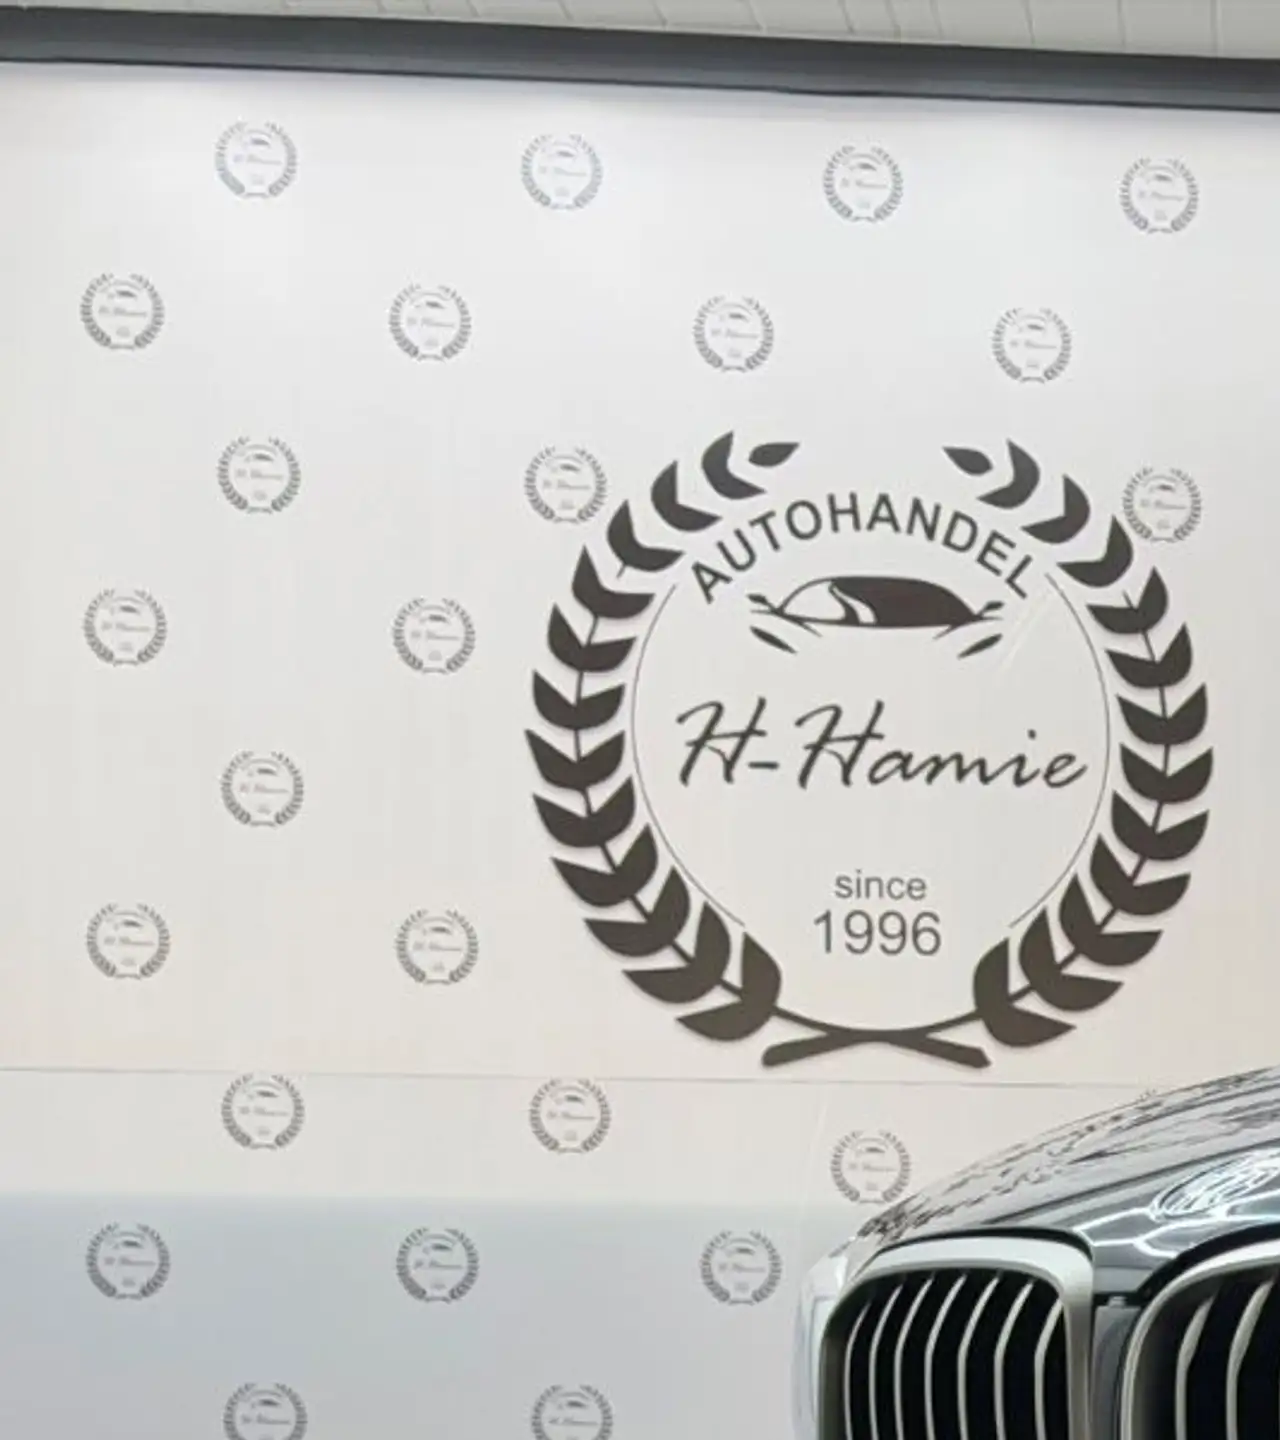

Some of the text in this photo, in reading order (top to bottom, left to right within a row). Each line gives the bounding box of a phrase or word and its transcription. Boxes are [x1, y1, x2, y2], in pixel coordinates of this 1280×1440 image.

[690, 491, 1036, 603] AUTOHANDEL
[676, 697, 1087, 789] H-Hamie
[835, 869, 927, 901] since
[814, 909, 941, 956] 1996
